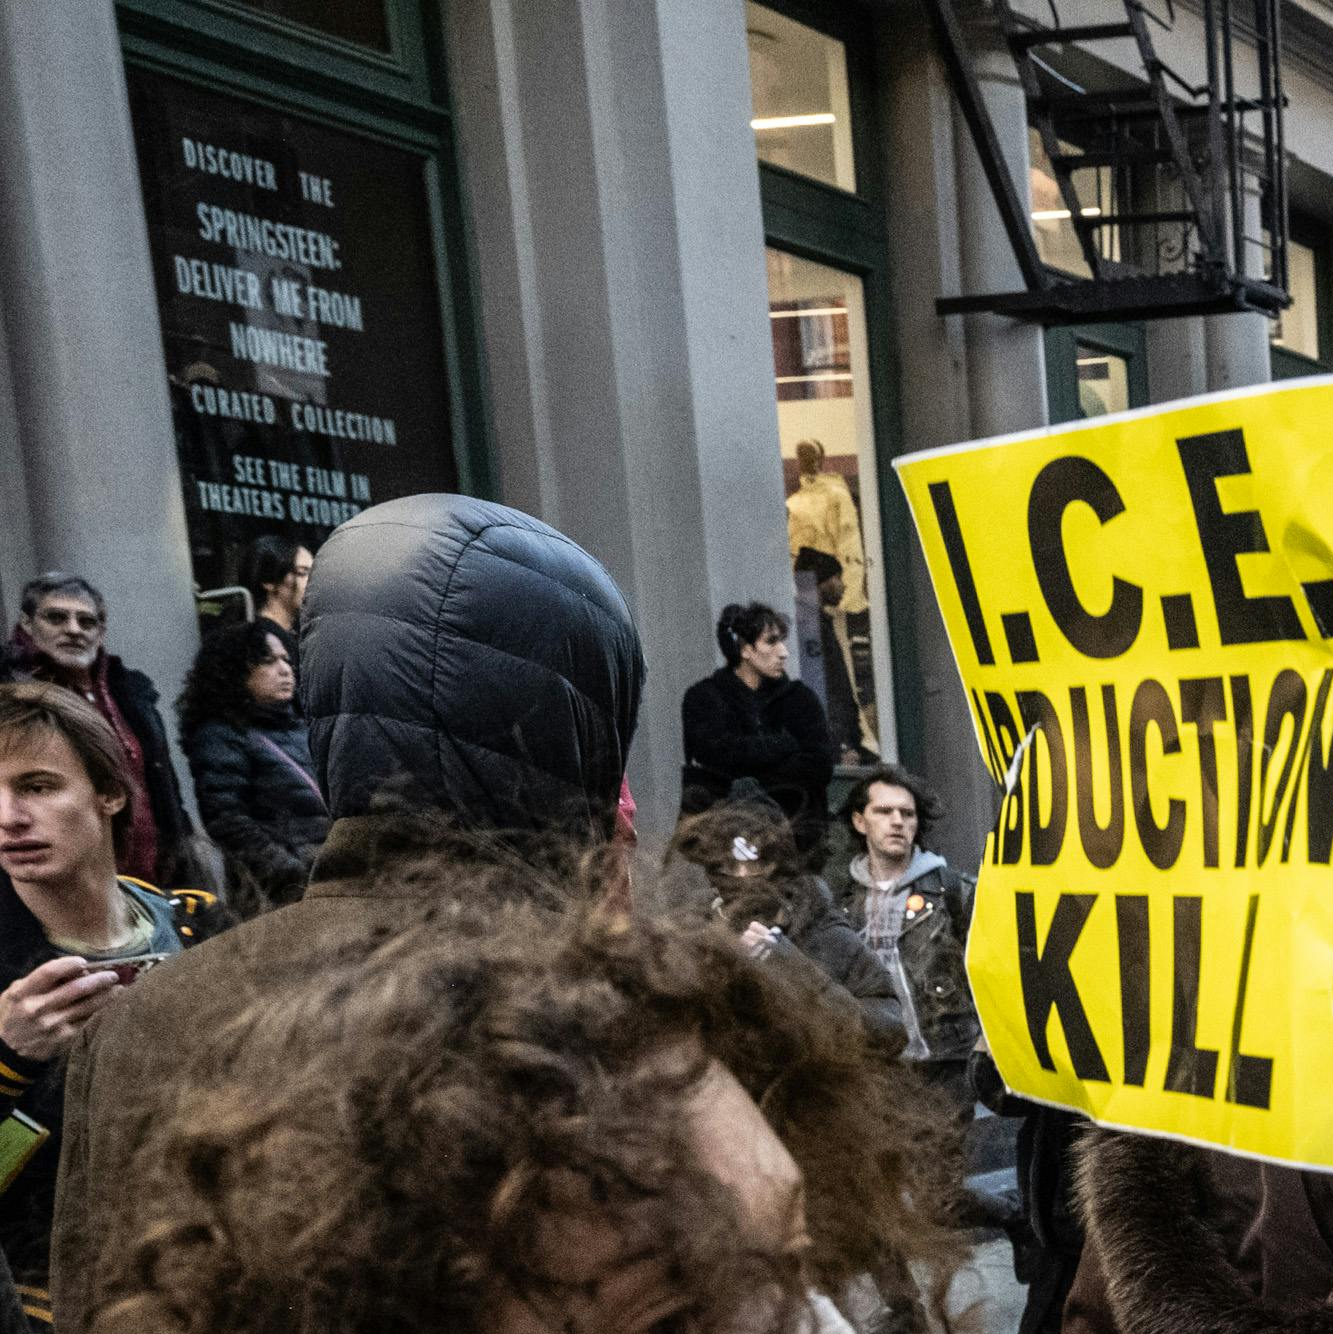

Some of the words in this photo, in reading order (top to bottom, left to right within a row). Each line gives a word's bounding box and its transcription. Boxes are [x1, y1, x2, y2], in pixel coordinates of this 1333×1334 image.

[182, 137, 278, 191] DISCOVER
[299, 170, 335, 208] THE
[196, 201, 343, 271] SPRINGSTEEN:
[174, 254, 264, 310] DELIVER
[271, 277, 304, 318] ME
[306, 285, 364, 331] FROM
[229, 321, 332, 378] NOWHERE
[191, 383, 277, 425] CURATED
[290, 402, 397, 446] COLLECTION
[197, 480, 285, 521] THEATERS
[232, 453, 267, 486] SEE
[267, 459, 302, 492] THE
[306, 465, 347, 499] FILM
[350, 472, 372, 501] IN
[1014, 890, 1275, 1111] KILL
